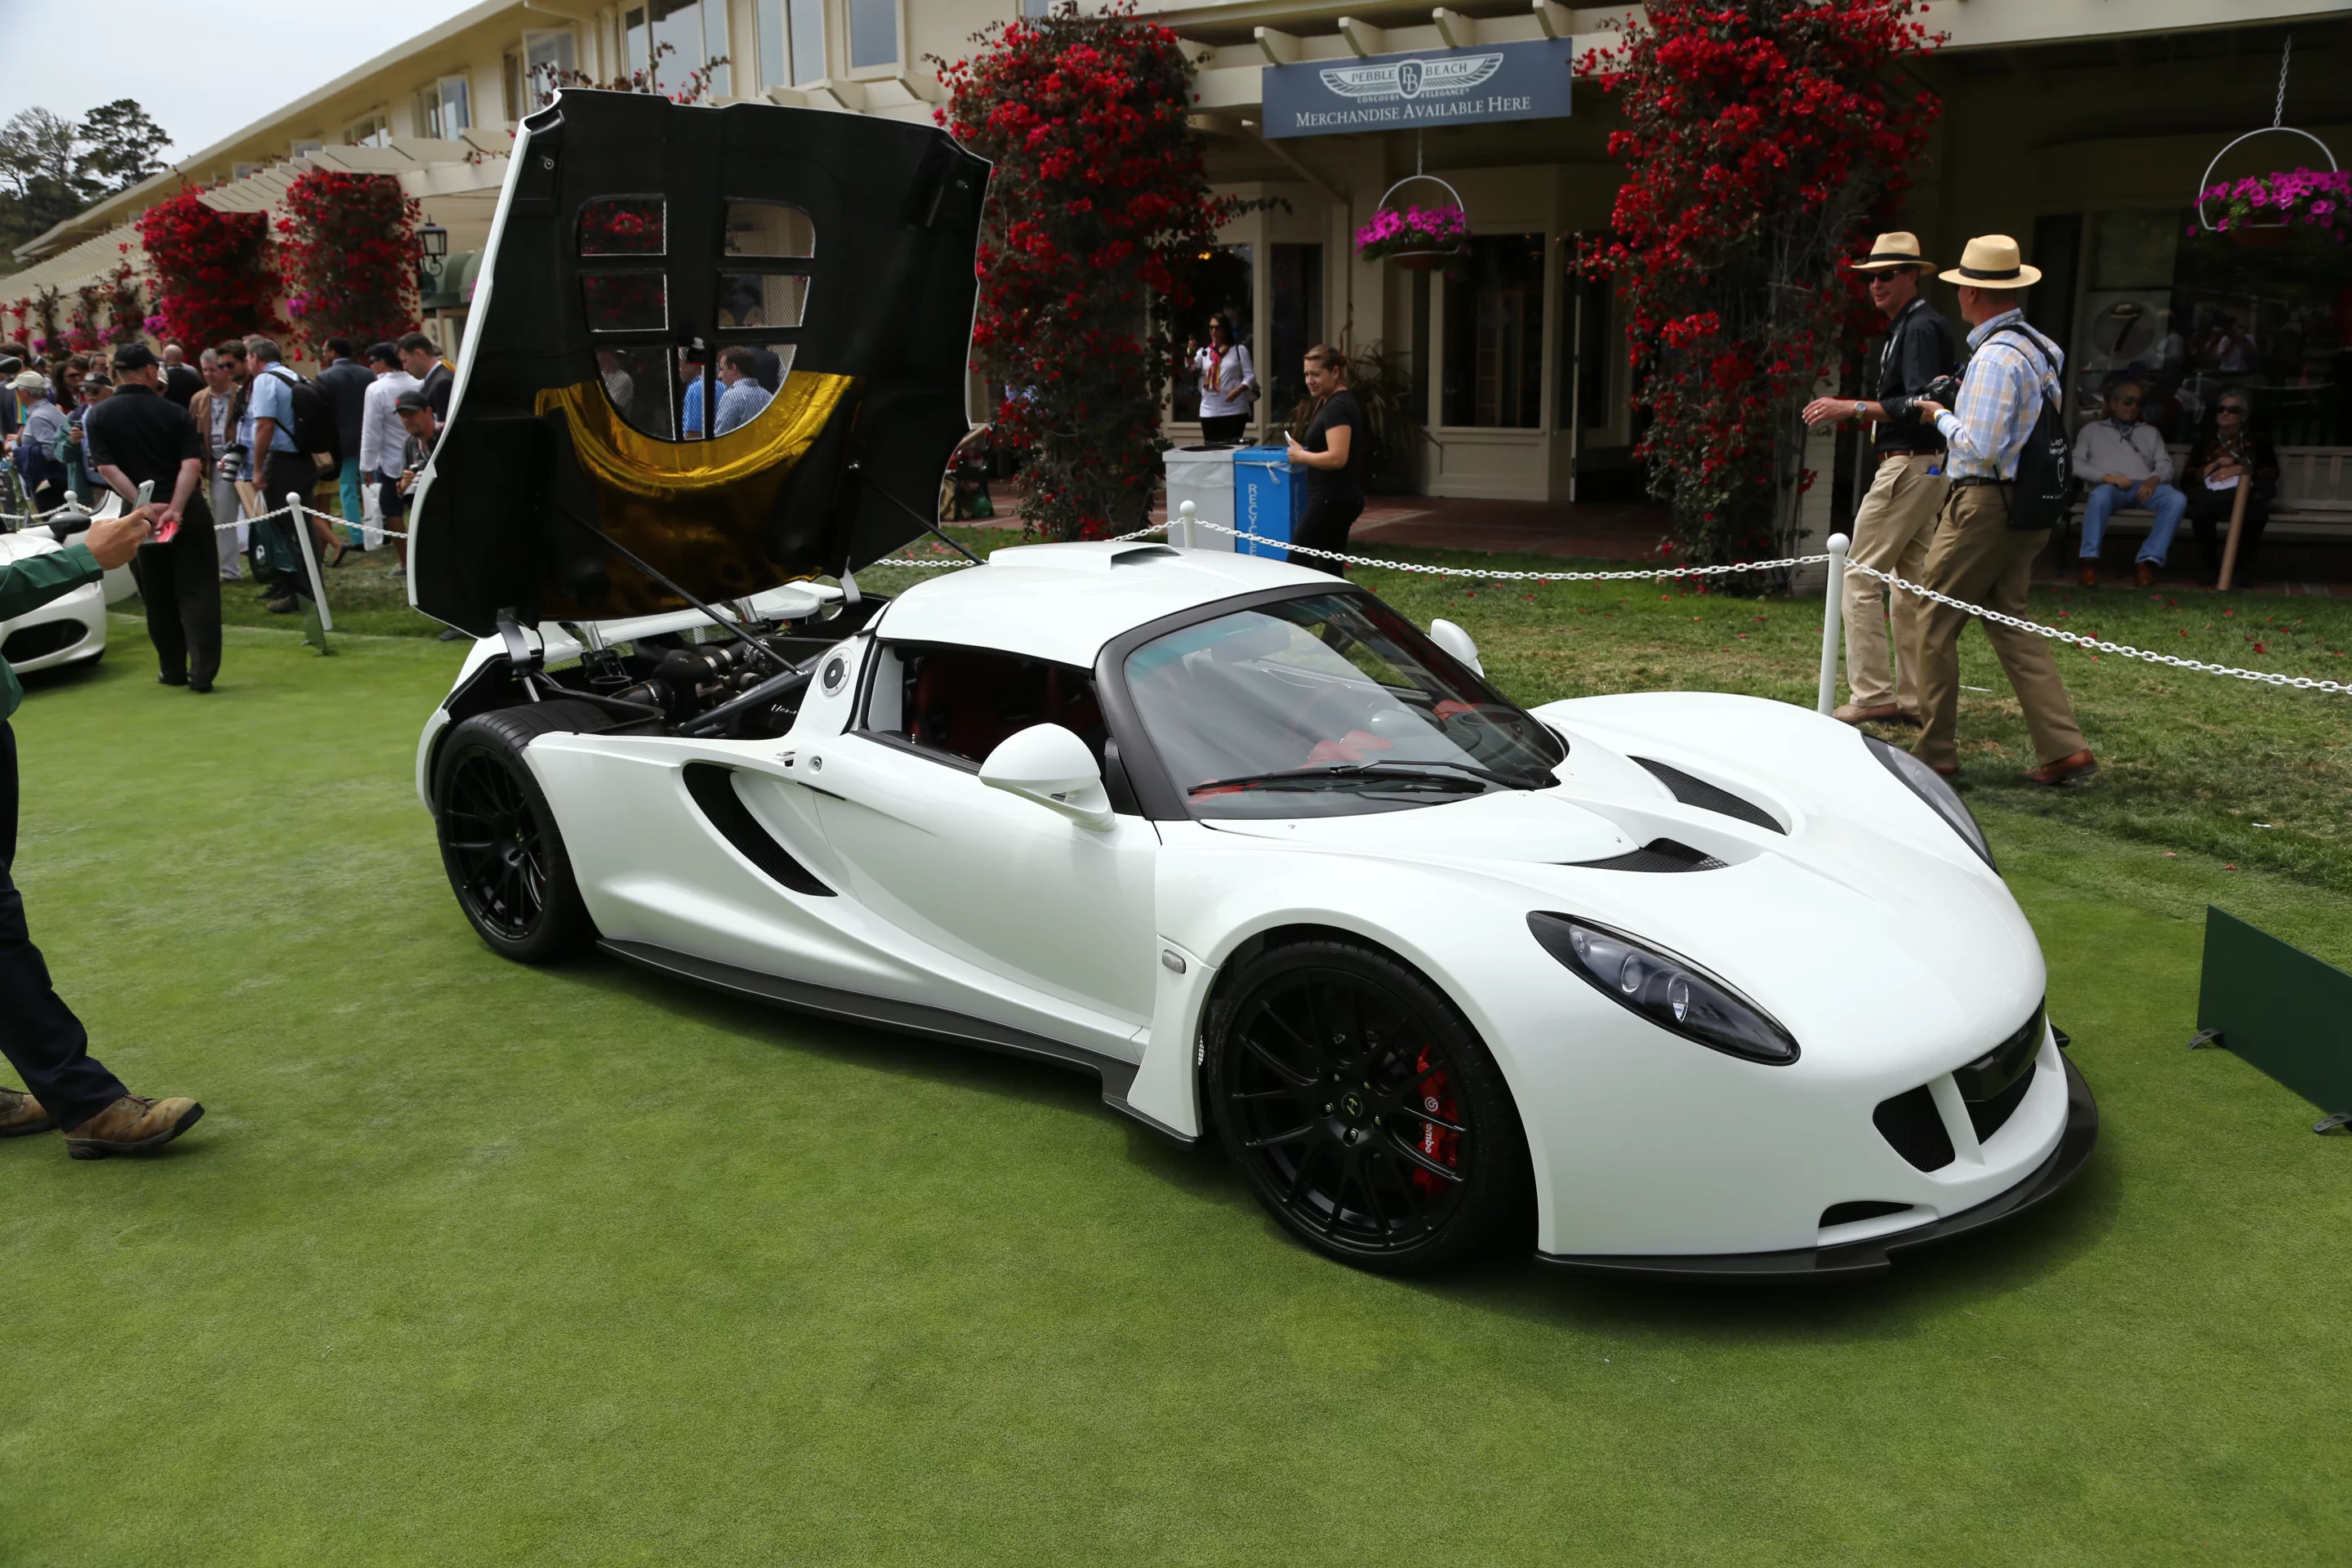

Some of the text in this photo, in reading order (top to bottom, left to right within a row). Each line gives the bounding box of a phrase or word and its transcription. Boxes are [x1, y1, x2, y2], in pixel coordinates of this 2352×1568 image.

[1352, 63, 1468, 82] PEBBLE BEACH
[1402, 65, 1419, 92] PB
[1295, 96, 1531, 127] MERCHANDISE AVAILABLE HERE
[1356, 93, 1400, 104] CONCOURS
[1248, 483, 1258, 555] RECYCLE
[1425, 1124, 1434, 1153] embo
